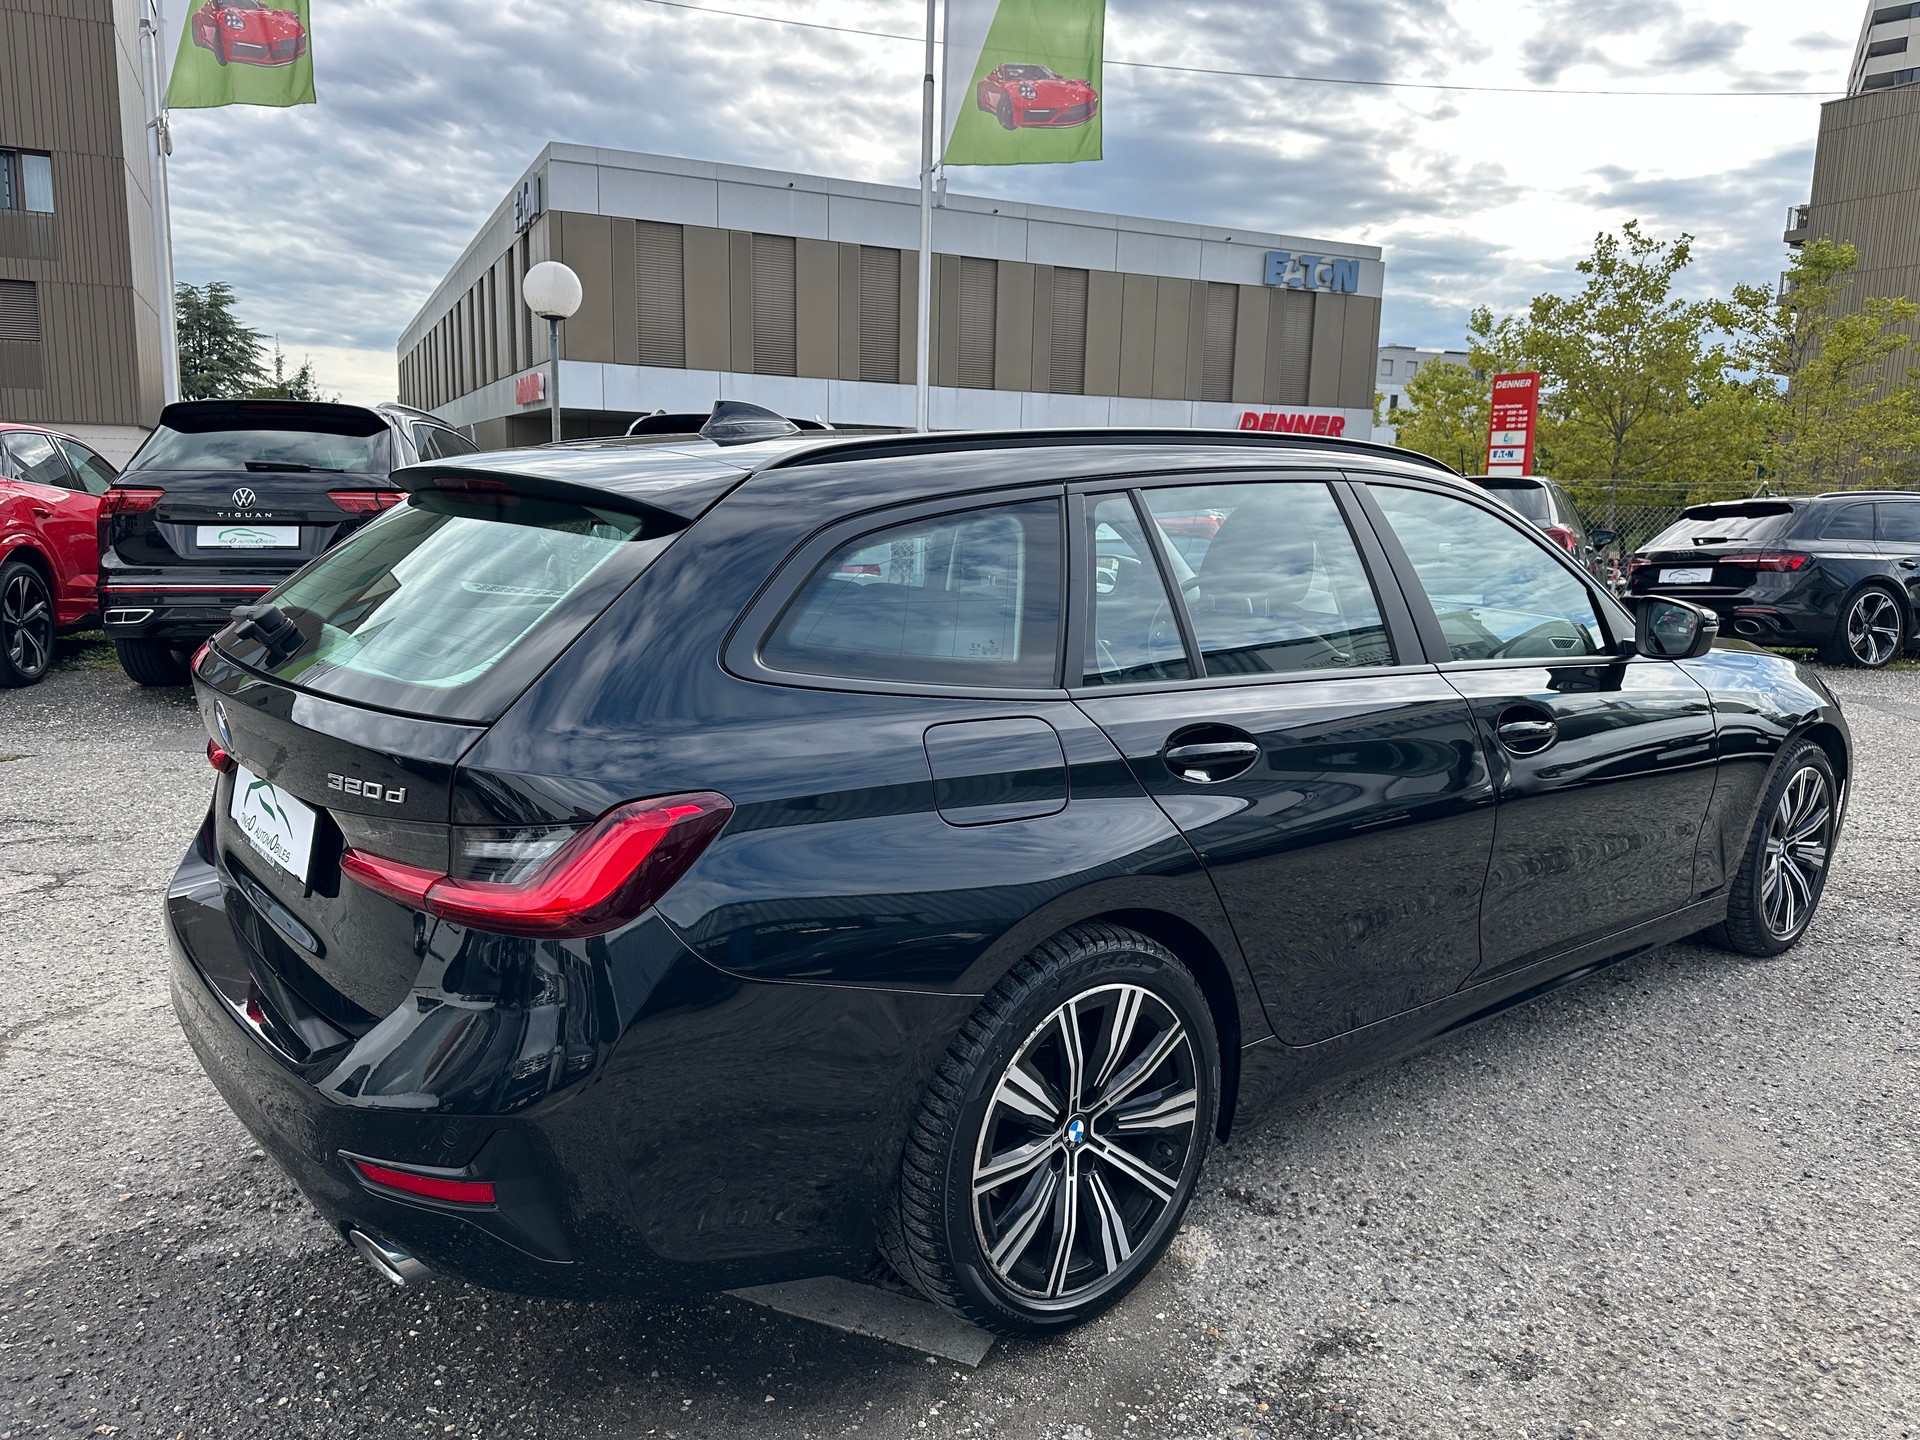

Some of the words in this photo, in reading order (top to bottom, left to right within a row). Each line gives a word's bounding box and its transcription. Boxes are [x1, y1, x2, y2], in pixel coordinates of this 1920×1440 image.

[1264, 250, 1360, 294] EATON
[1495, 378, 1532, 390] DENNER
[1239, 411, 1346, 438] DENNER
[253, 827, 291, 863] AUTOMOBILES
